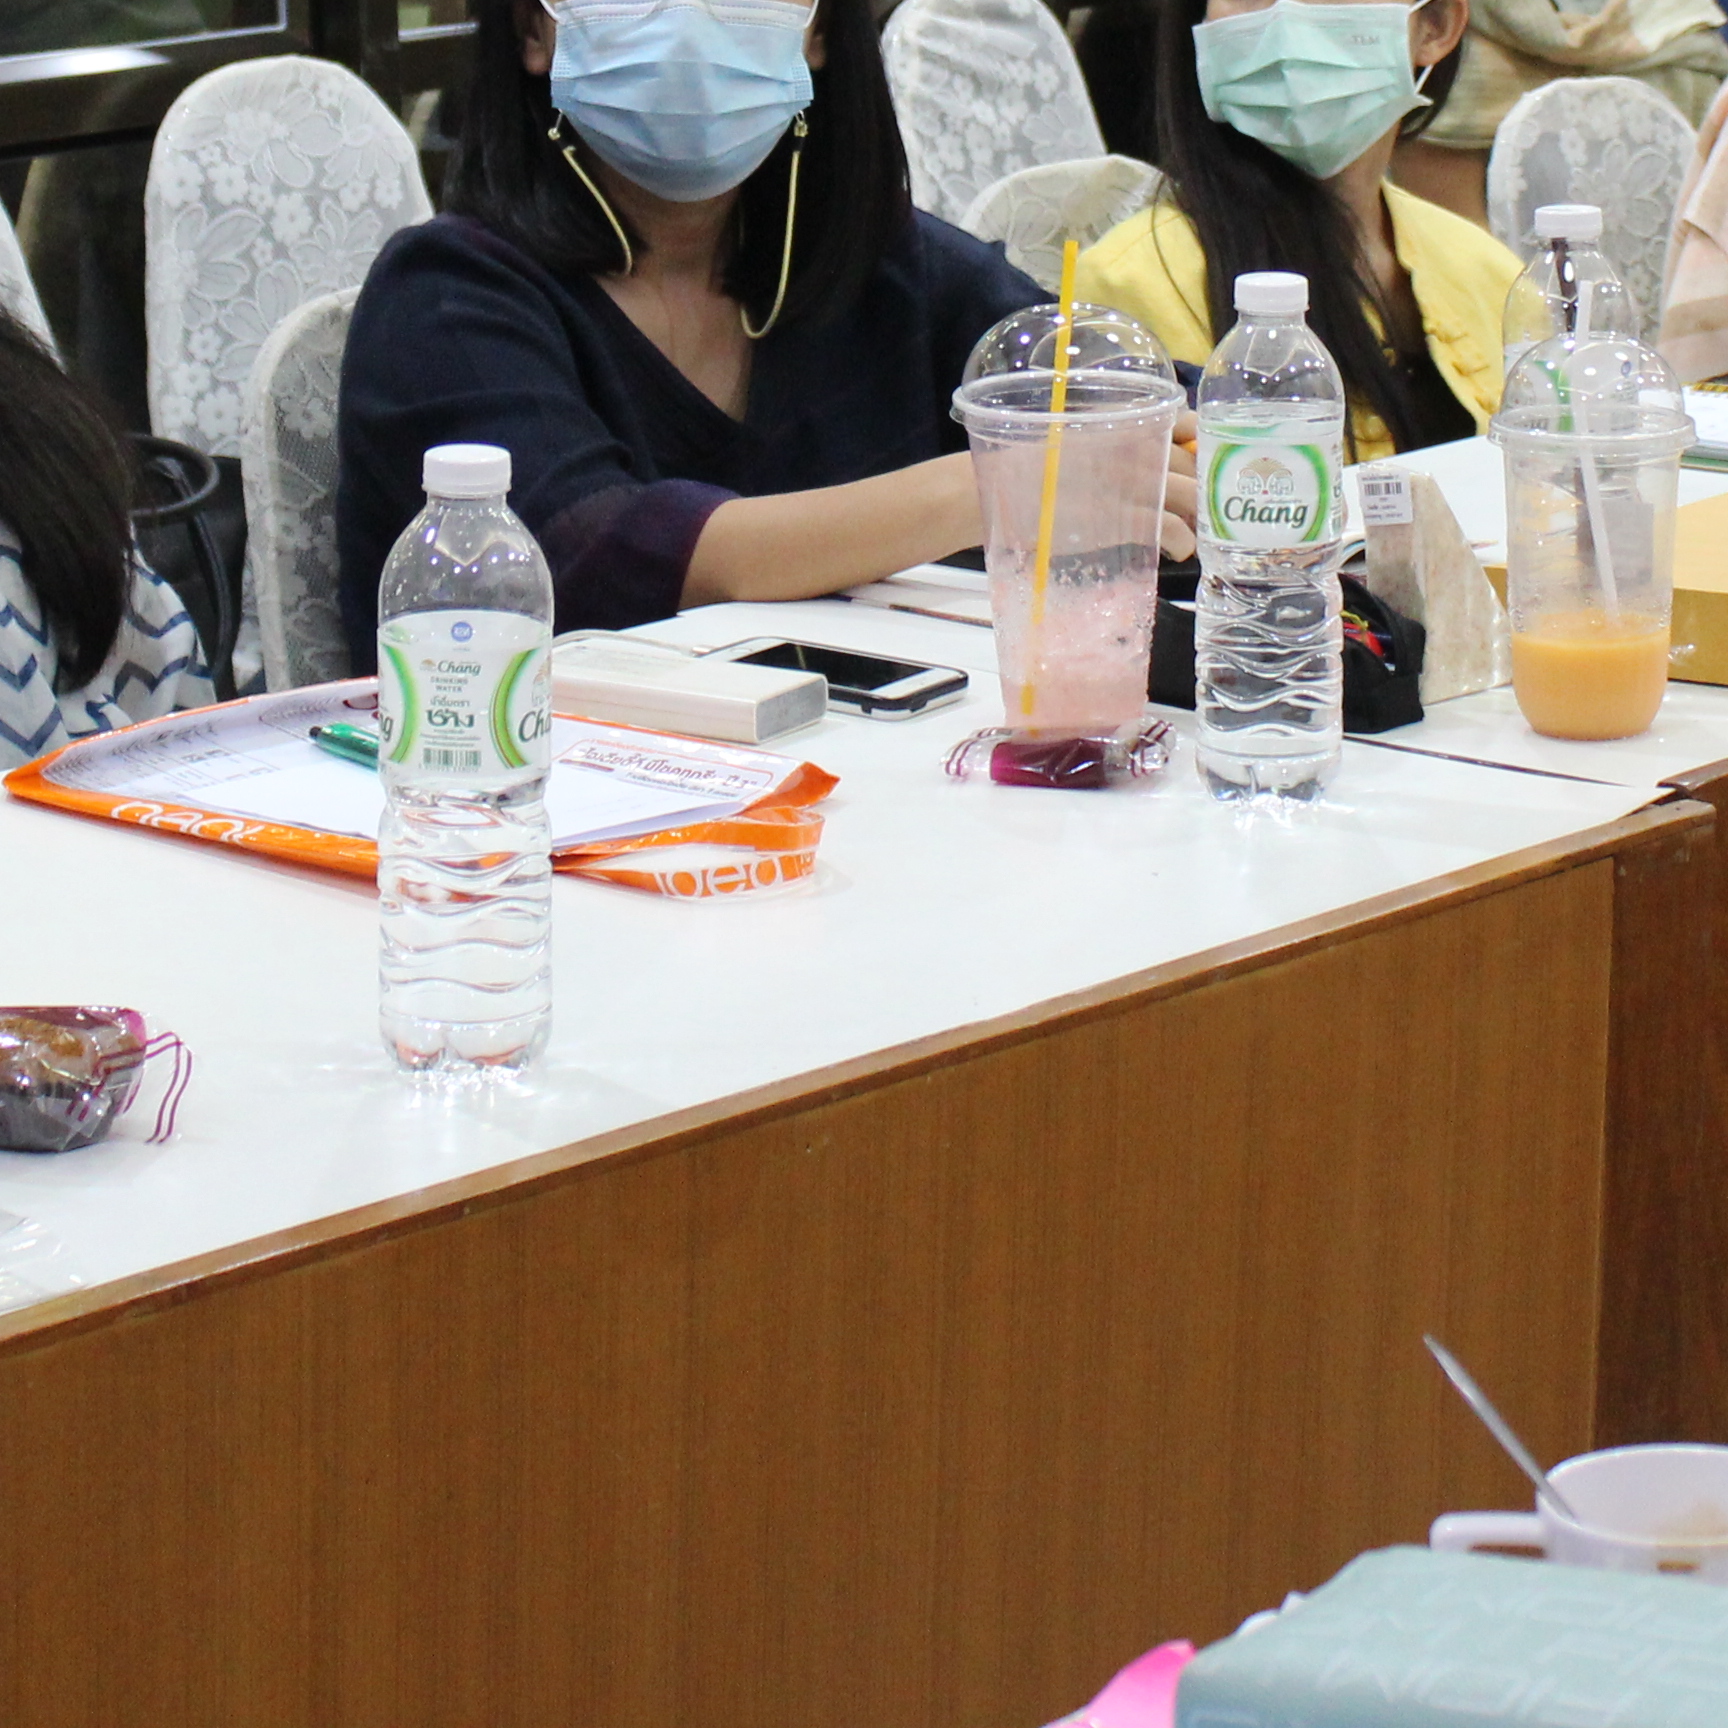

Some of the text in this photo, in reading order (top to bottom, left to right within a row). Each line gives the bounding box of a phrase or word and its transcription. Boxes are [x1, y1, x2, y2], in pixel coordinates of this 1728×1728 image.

[1223, 495, 1309, 529] Chang
[437, 659, 482, 676] Chang
[435, 684, 463, 693] WATER
